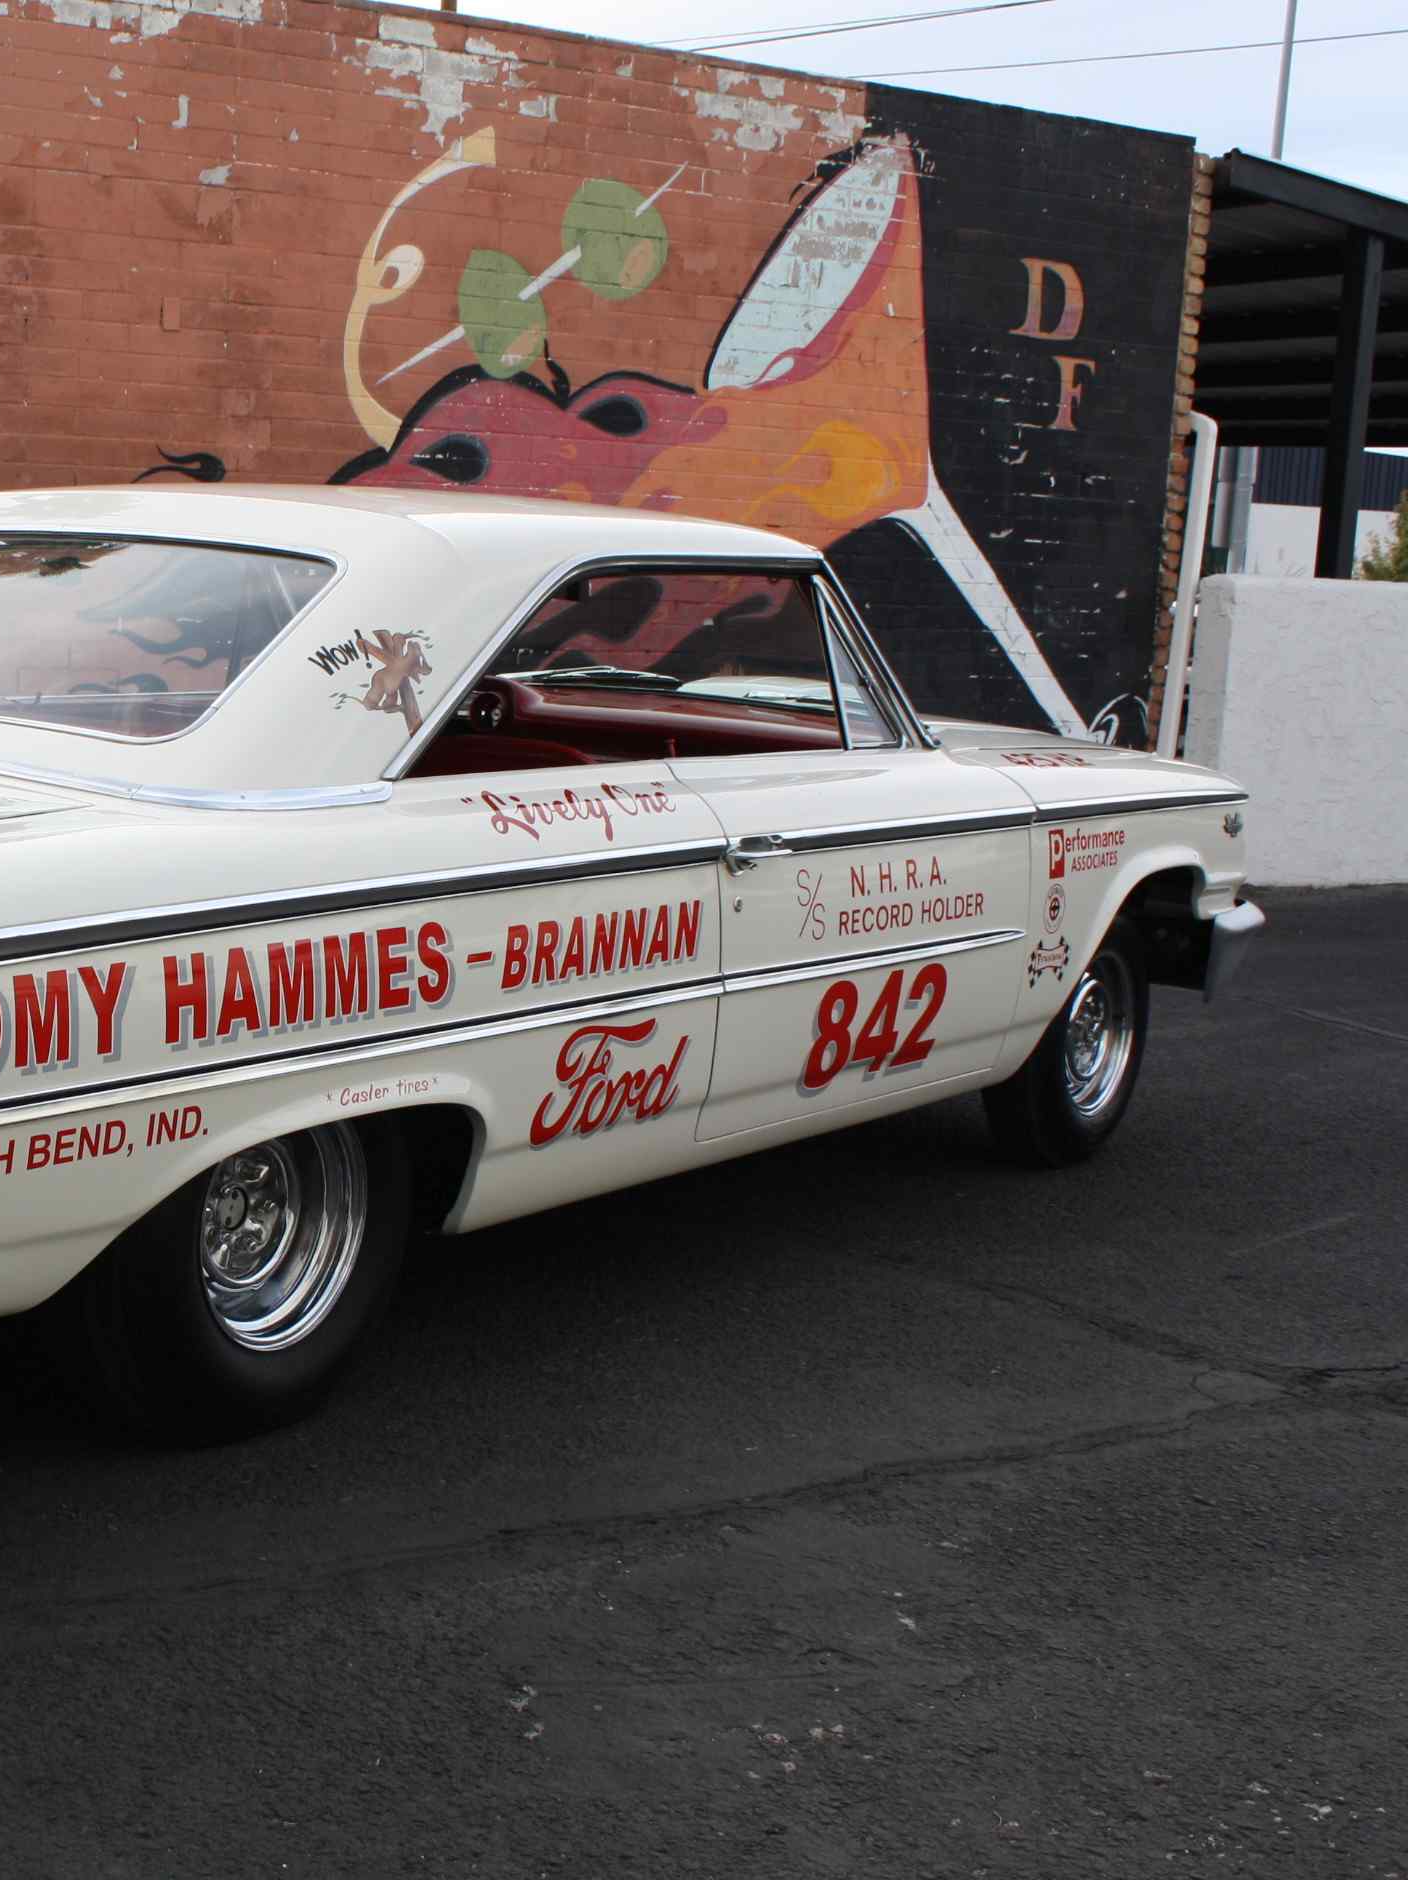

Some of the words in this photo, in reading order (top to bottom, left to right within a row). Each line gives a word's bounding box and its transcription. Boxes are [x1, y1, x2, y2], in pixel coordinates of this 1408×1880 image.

[1071, 851, 1118, 872] ASSOCIATES
[838, 902, 913, 937] RECORD
[920, 892, 984, 925] HOLDER
[162, 921, 456, 1051] HAMMES
[500, 899, 704, 996] BRANNAN
[802, 962, 949, 1096] 842
[340, 1084, 390, 1106] Casler
[396, 1078, 429, 1097] tires
[528, 1017, 690, 1150] Ford
[26, 1118, 134, 1171] BEND,
[145, 1104, 209, 1149] IND.
